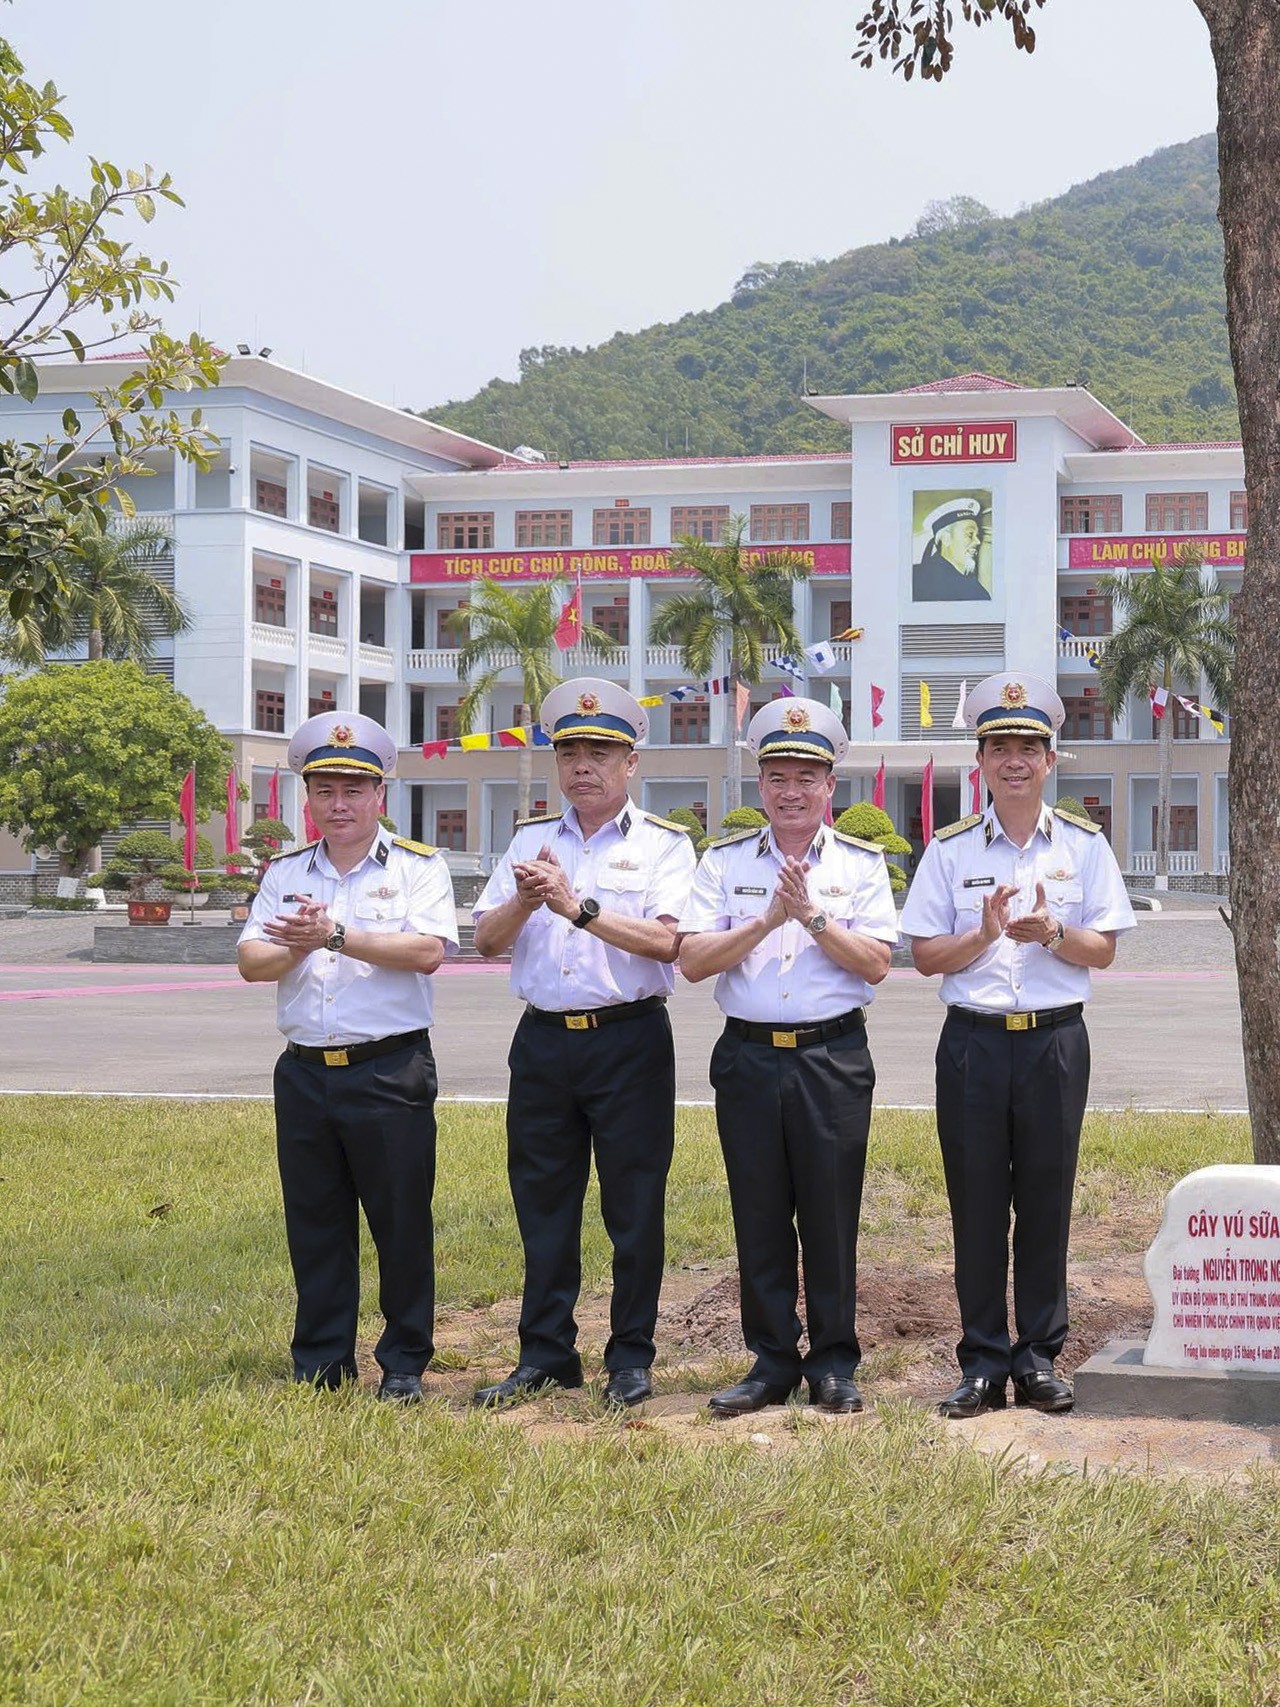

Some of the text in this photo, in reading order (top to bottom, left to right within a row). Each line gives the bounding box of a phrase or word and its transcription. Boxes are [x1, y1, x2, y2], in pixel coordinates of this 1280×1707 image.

[898, 426, 1008, 457] SỞ CHỈ HUY
[444, 556, 483, 575] TÍCH
[488, 555, 524, 577] CỰC
[530, 552, 564, 574] CHỦ
[570, 552, 624, 577] ĐỘNG,
[1092, 541, 1129, 561] LÀM
[1131, 538, 1167, 560] CHỦ
[1187, 1209, 1280, 1239] CÂY VÚ SỮA
[1203, 1248, 1237, 1282] NGUYỄN
[1239, 1258, 1268, 1287] TRỌNG
